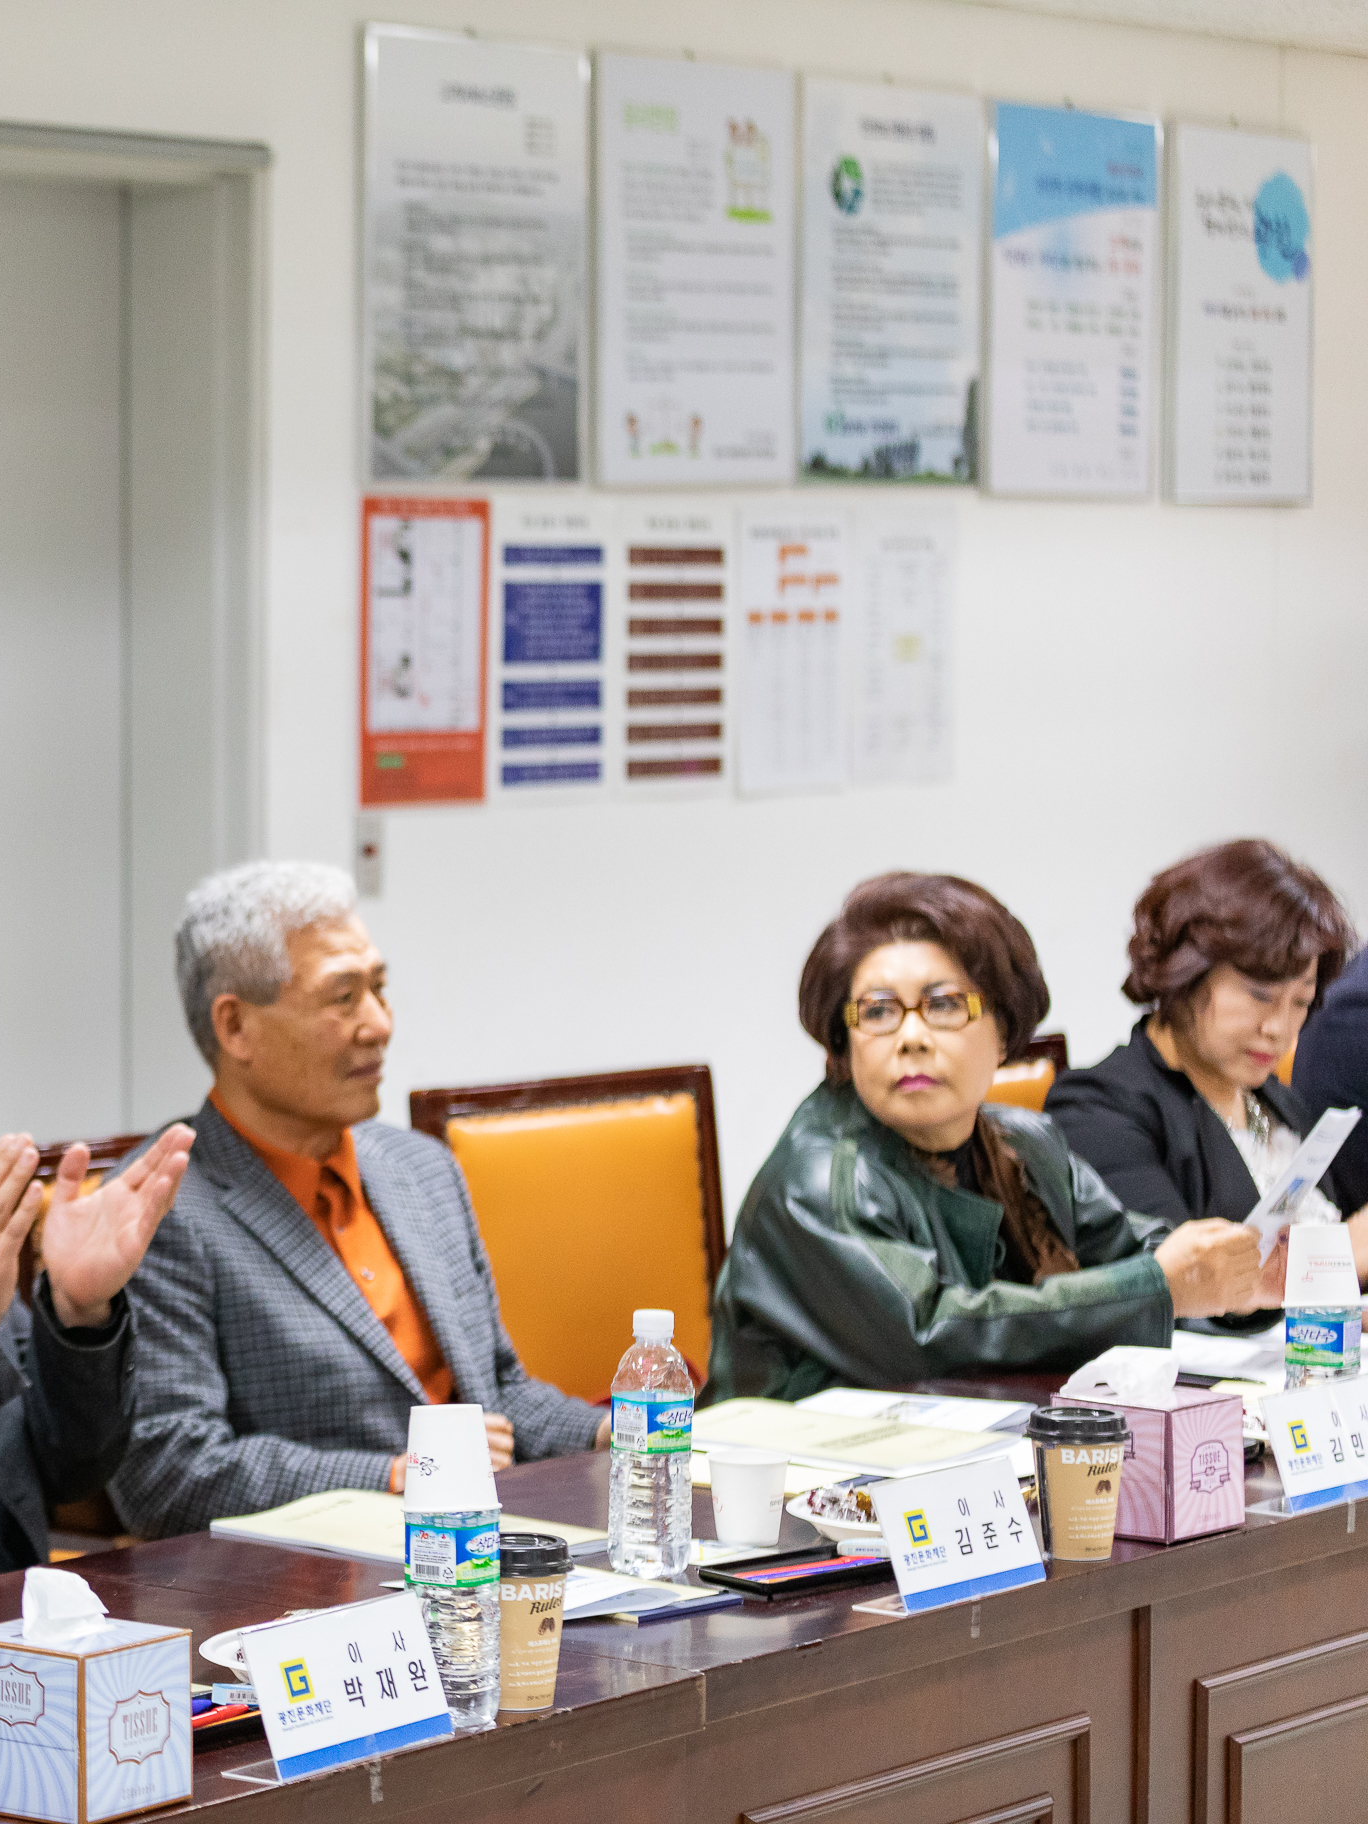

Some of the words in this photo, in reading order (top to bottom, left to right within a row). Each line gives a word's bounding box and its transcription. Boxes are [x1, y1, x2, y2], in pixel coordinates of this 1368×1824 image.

[1199, 1450, 1221, 1466] TISSUE
[1087, 1462, 1118, 1477] Rules
[902, 1545, 948, 1567] 광진문화재단
[529, 1596, 564, 1615] Rules
[277, 1699, 333, 1726] 광진문화재단
[122, 1707, 158, 1741] TISSUE
